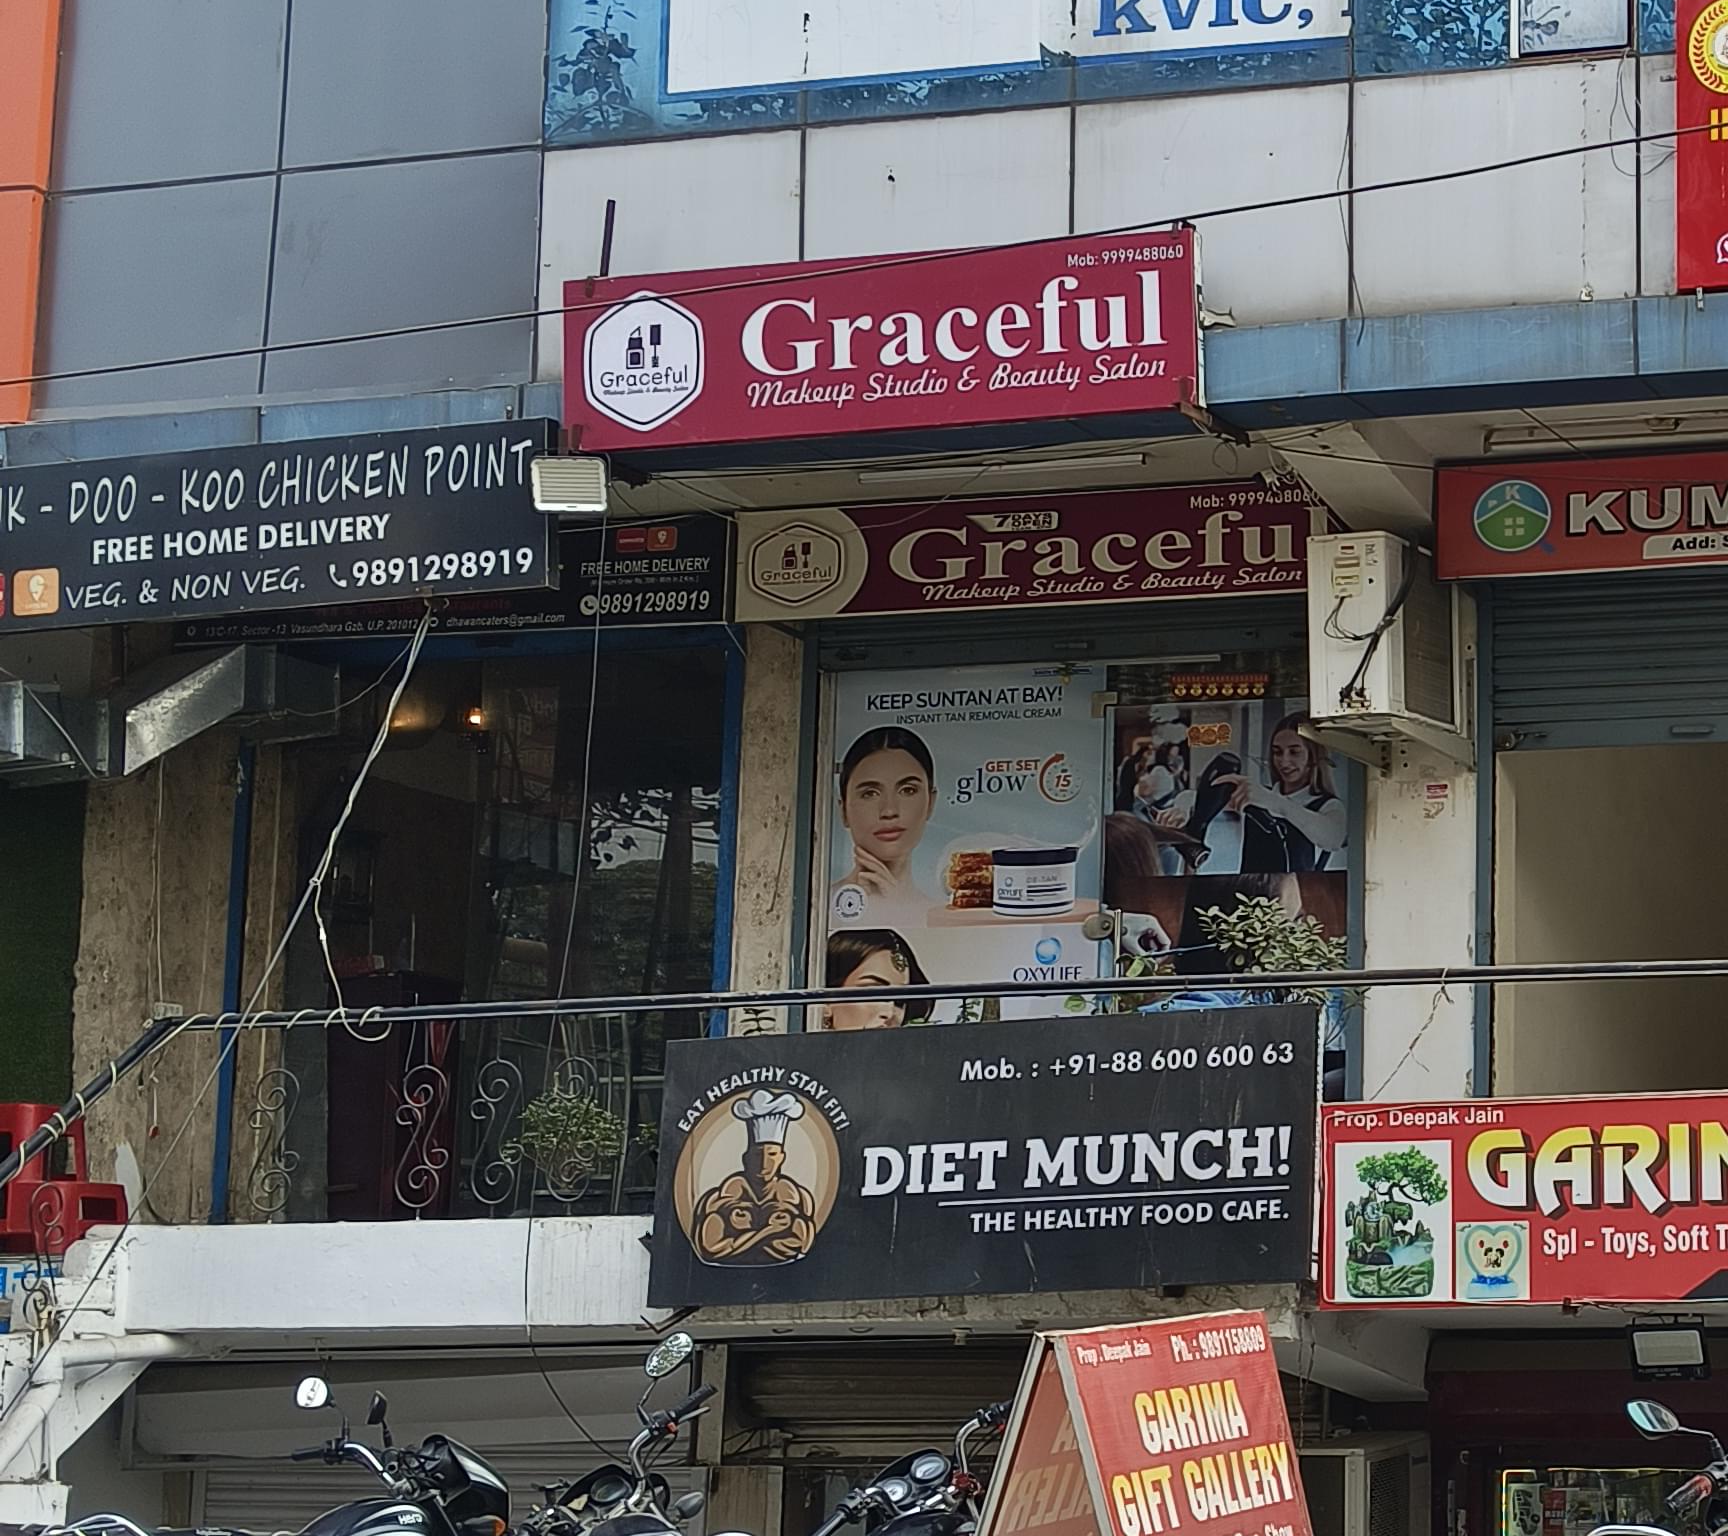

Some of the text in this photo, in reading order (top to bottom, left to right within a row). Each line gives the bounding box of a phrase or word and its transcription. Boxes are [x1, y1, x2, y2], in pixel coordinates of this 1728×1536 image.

[741, 268, 1168, 378] Graceful
[600, 365, 688, 388] Graceful
[747, 357, 1165, 408] Makeup Studio Beauty Salon
[69, 438, 532, 524] DOO KOO CHICKEN POINT
[93, 514, 391, 564] FREE HOME DELIVERY
[1672, 534, 1717, 552] Add:
[66, 548, 533, 609] VEG. NON 9891298919
[614, 557, 710, 573] HOME DELIVERY
[922, 570, 1226, 601] Makeup Studio Beauty
[867, 686, 1063, 711] KEEP SUNTAN AT BAY!
[1023, 708, 1062, 719] CREAM
[985, 759, 1041, 773] GET SET
[956, 768, 1029, 805] glow
[1150, 1042, 1295, 1072] 600 600 63
[678, 1066, 828, 1135] EAT HEALTHY STAY
[1389, 1104, 1505, 1130] Deepak Jain
[860, 1126, 1293, 1197] DIET MUNCH!
[970, 1198, 1290, 1233] THE HEALTHY FOOD CAFE.
[1542, 1231, 1578, 1261] Spl
[1601, 1226, 1657, 1258] Toys,
[1662, 1224, 1710, 1253] Soft
[1135, 1379, 1249, 1454] GARIMA
[1182, 1442, 1294, 1522] GALLERY
